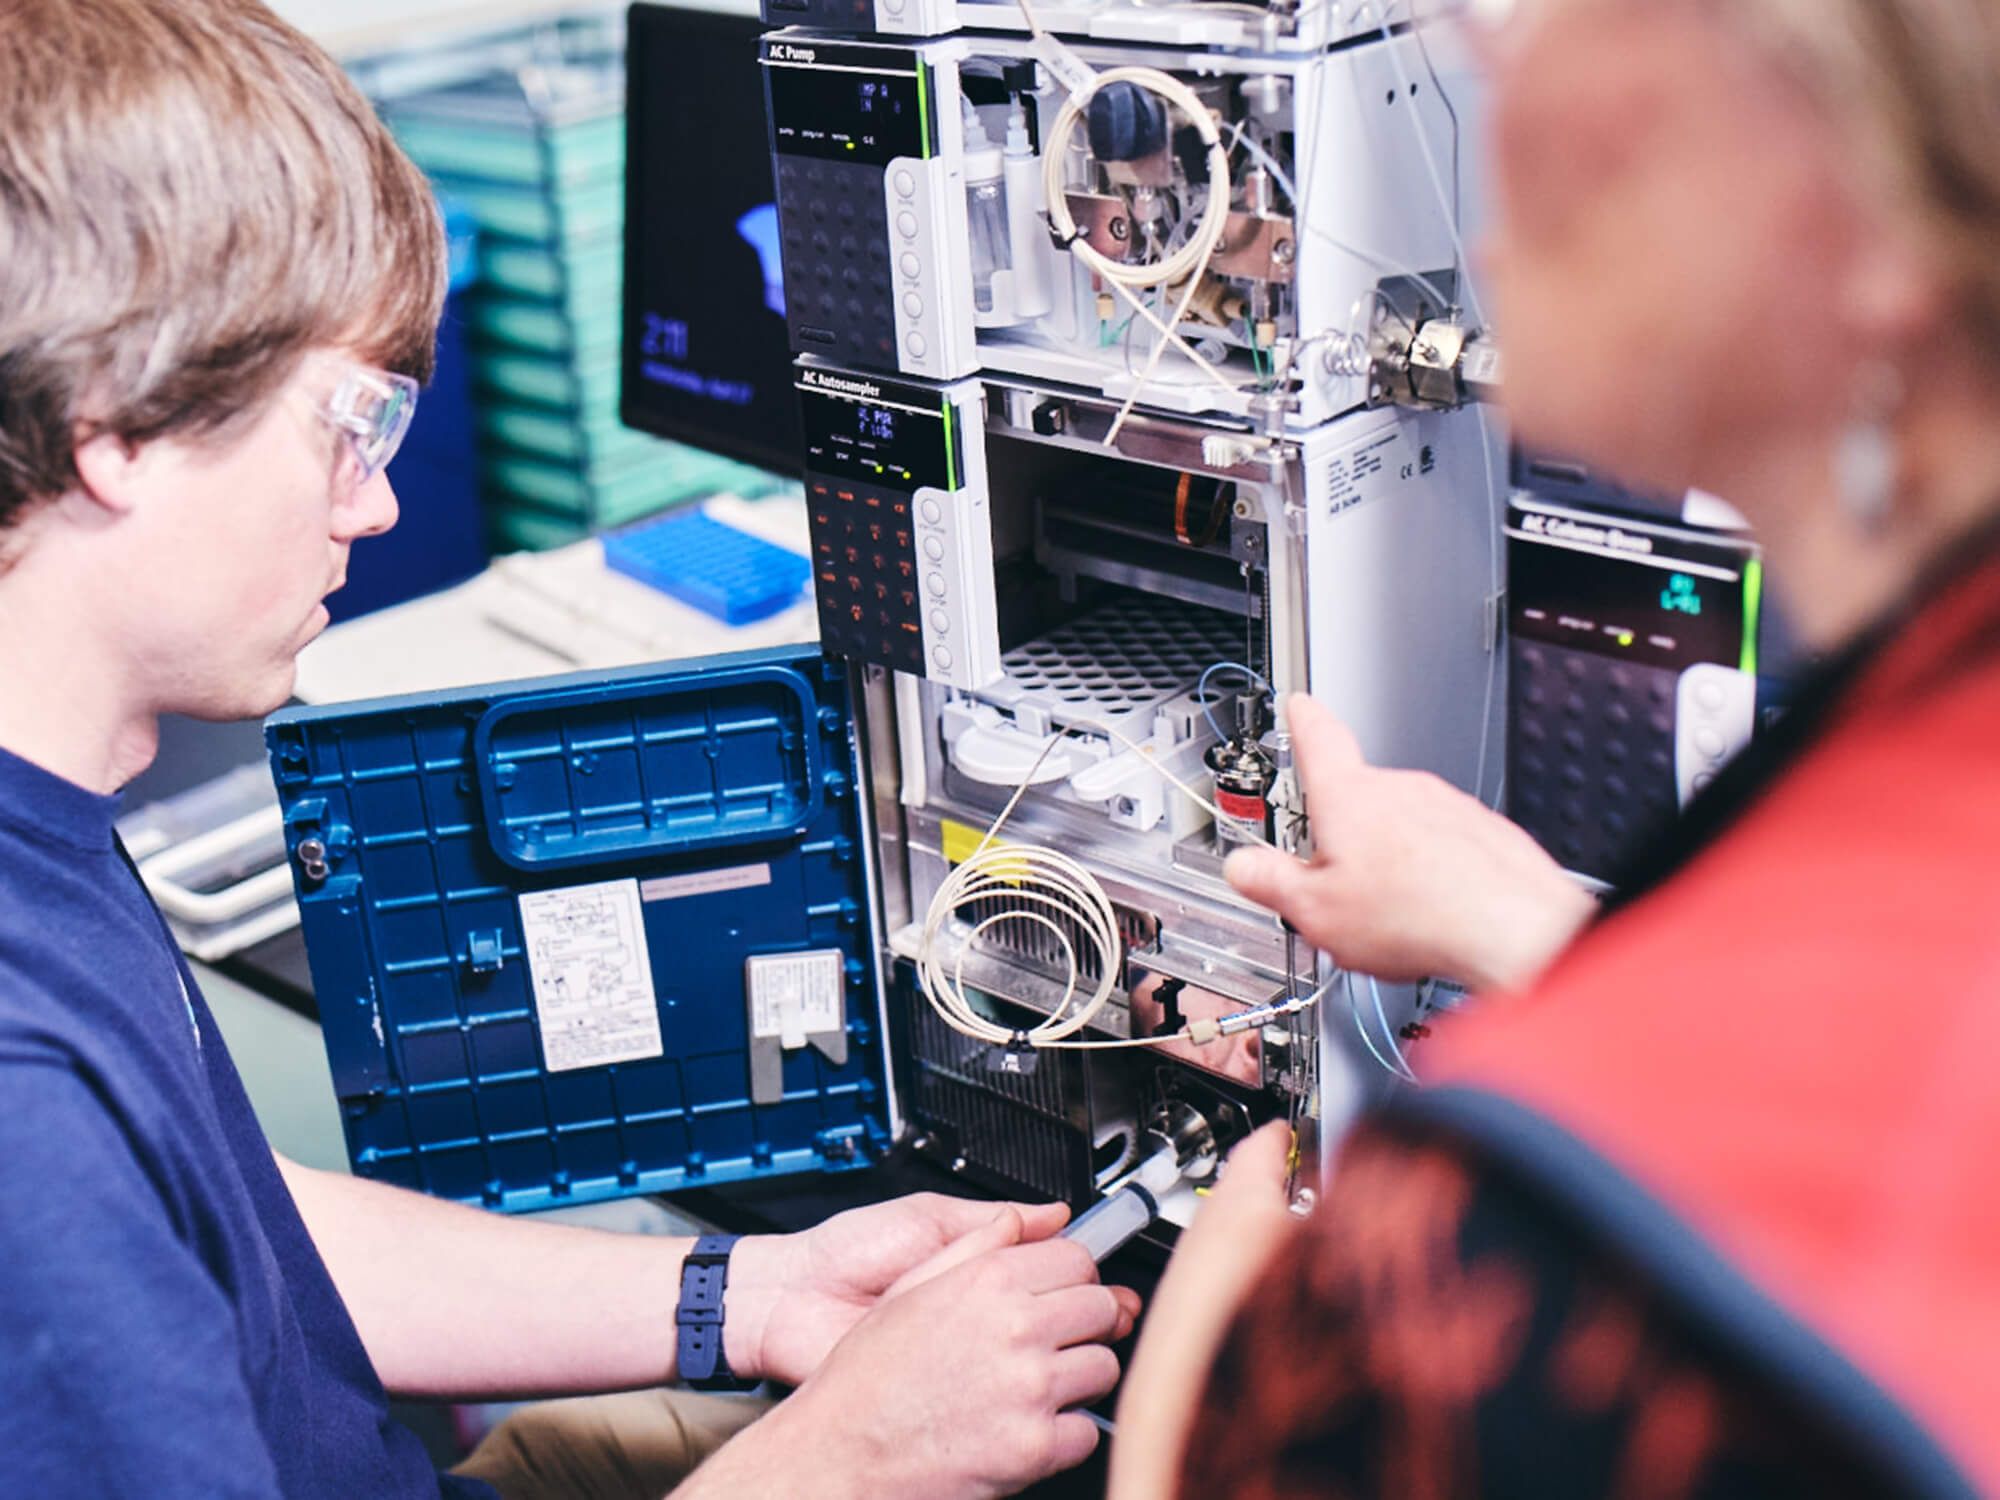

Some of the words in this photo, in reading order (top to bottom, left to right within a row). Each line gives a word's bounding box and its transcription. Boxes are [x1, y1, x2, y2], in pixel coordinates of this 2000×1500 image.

[770, 44, 784, 59] AC
[786, 45, 815, 65] Pump
[802, 370, 817, 385] AC
[818, 373, 880, 397] Autosampler
